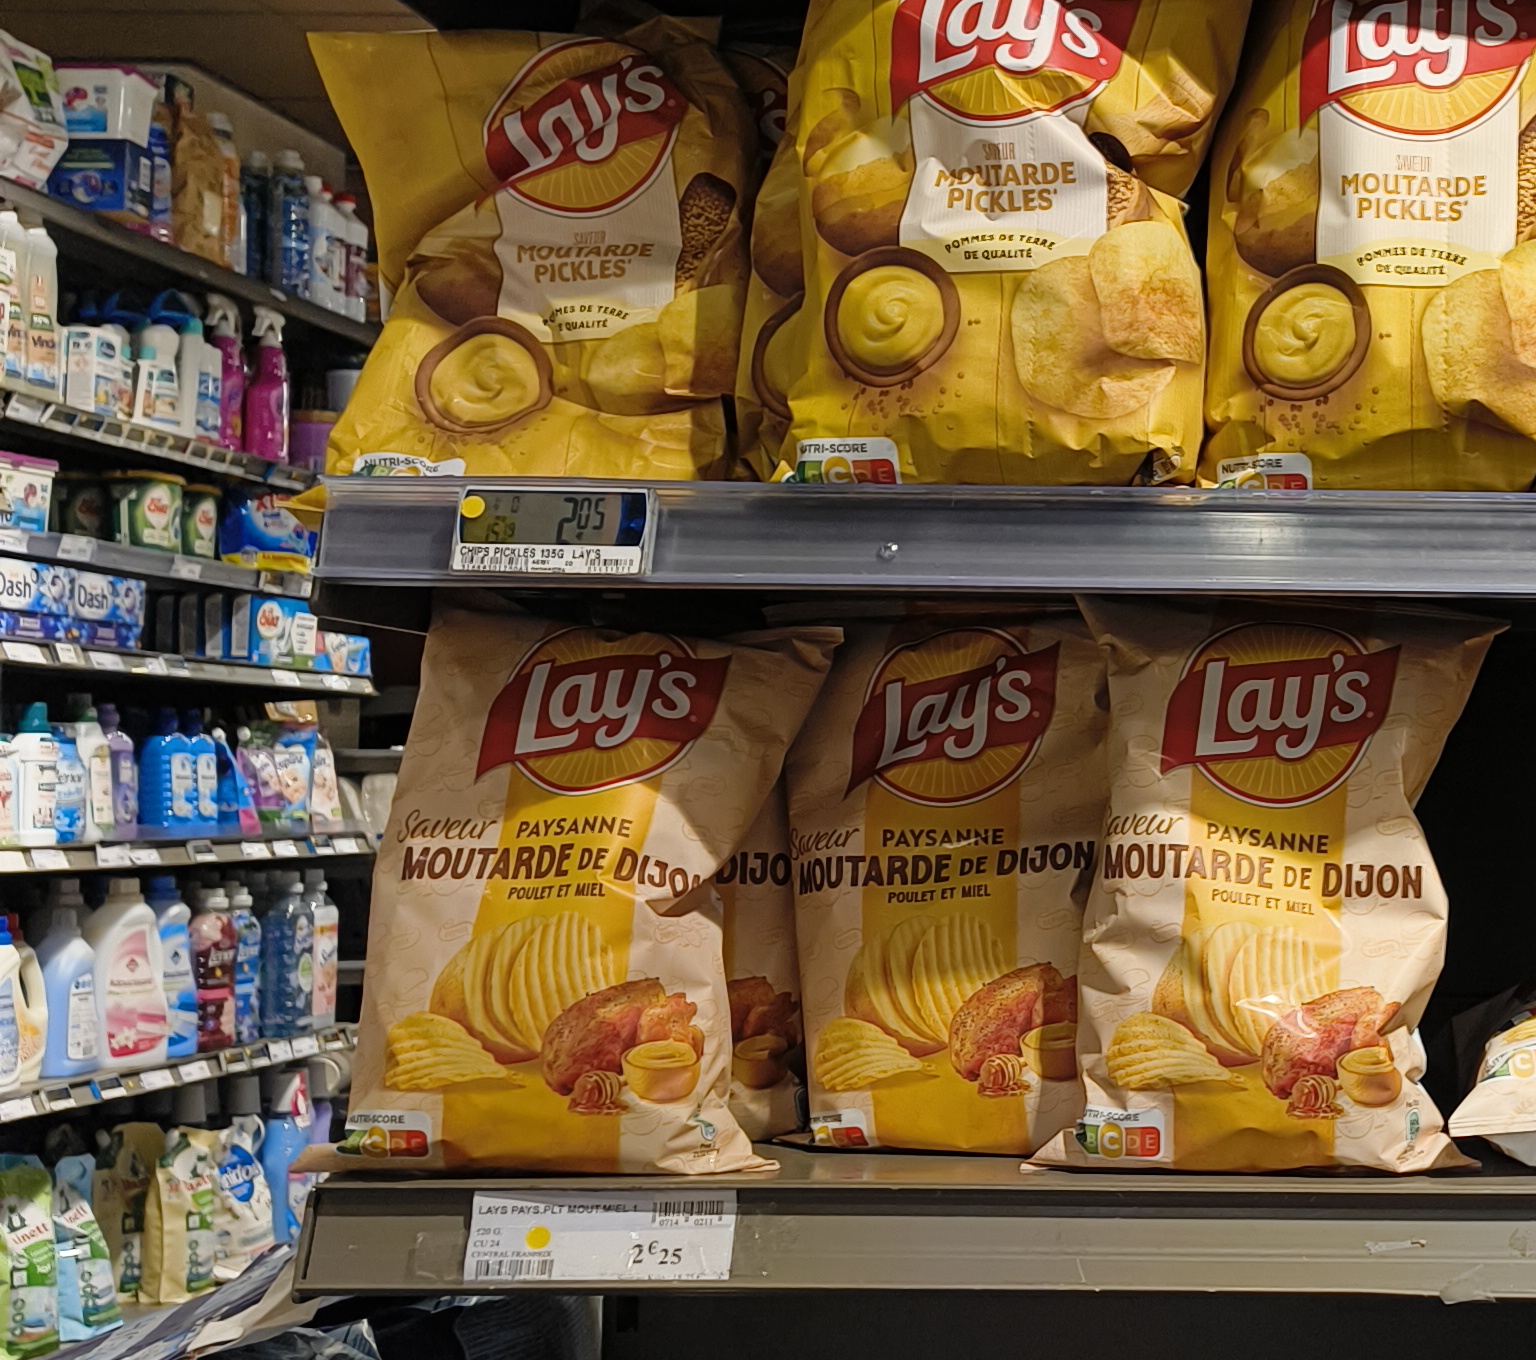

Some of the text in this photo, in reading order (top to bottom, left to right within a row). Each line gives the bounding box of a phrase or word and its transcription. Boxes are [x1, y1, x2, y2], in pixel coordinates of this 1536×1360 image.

[933, 161, 1077, 188] MOUTARDE
[460, 547, 601, 559] CHIPS PICKLES 135G LAY'S
[78, 584, 108, 609] Dash
[514, 653, 697, 755] Lay's
[1195, 653, 1372, 759] Lay's
[397, 809, 500, 845] Saveur
[516, 815, 634, 840] PAYSANNE
[1206, 822, 1330, 855] PAYSANNE
[401, 842, 571, 882] MOUTARDE
[574, 848, 606, 872] DE
[1103, 843, 1423, 900] MOUTARDE DE DIJON
[507, 883, 606, 901] POULET ET MIEL
[478, 1205, 508, 1215] LAYS
